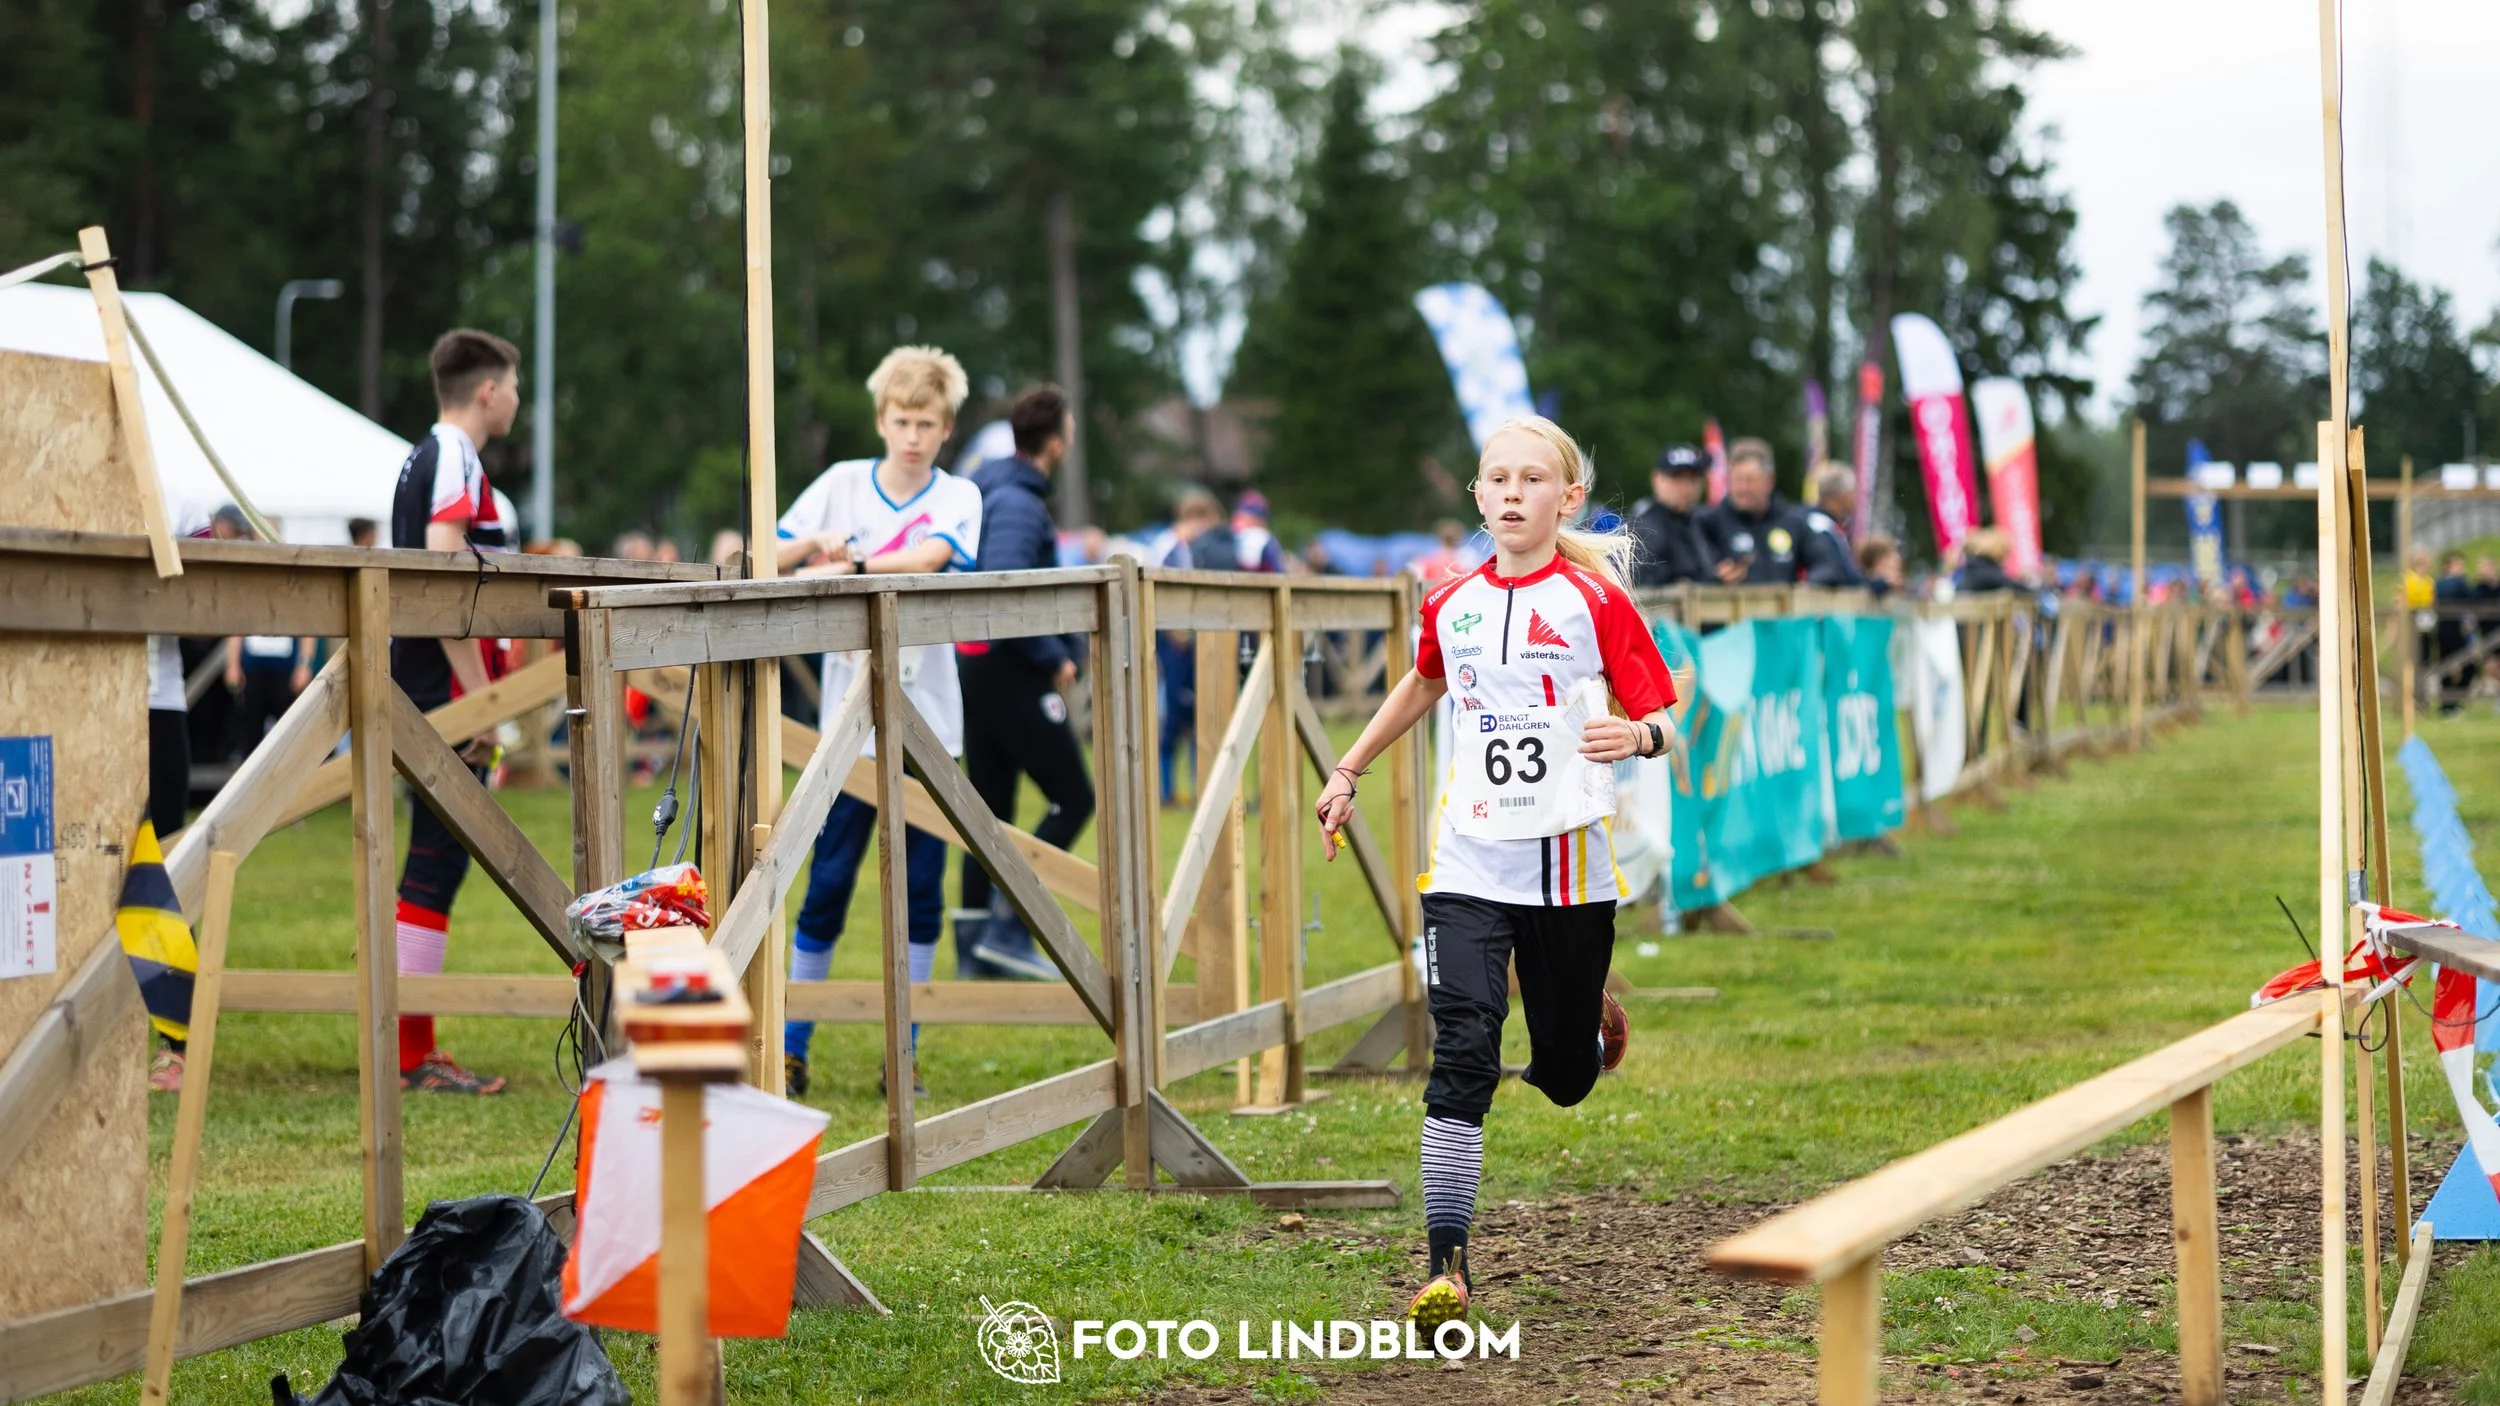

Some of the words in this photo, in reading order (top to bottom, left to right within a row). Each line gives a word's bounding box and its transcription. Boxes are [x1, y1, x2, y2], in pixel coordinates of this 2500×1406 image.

[1498, 713, 1530, 723] BENGT
[1499, 721, 1550, 731] DAHLGREN
[1485, 736, 1547, 786] 63
